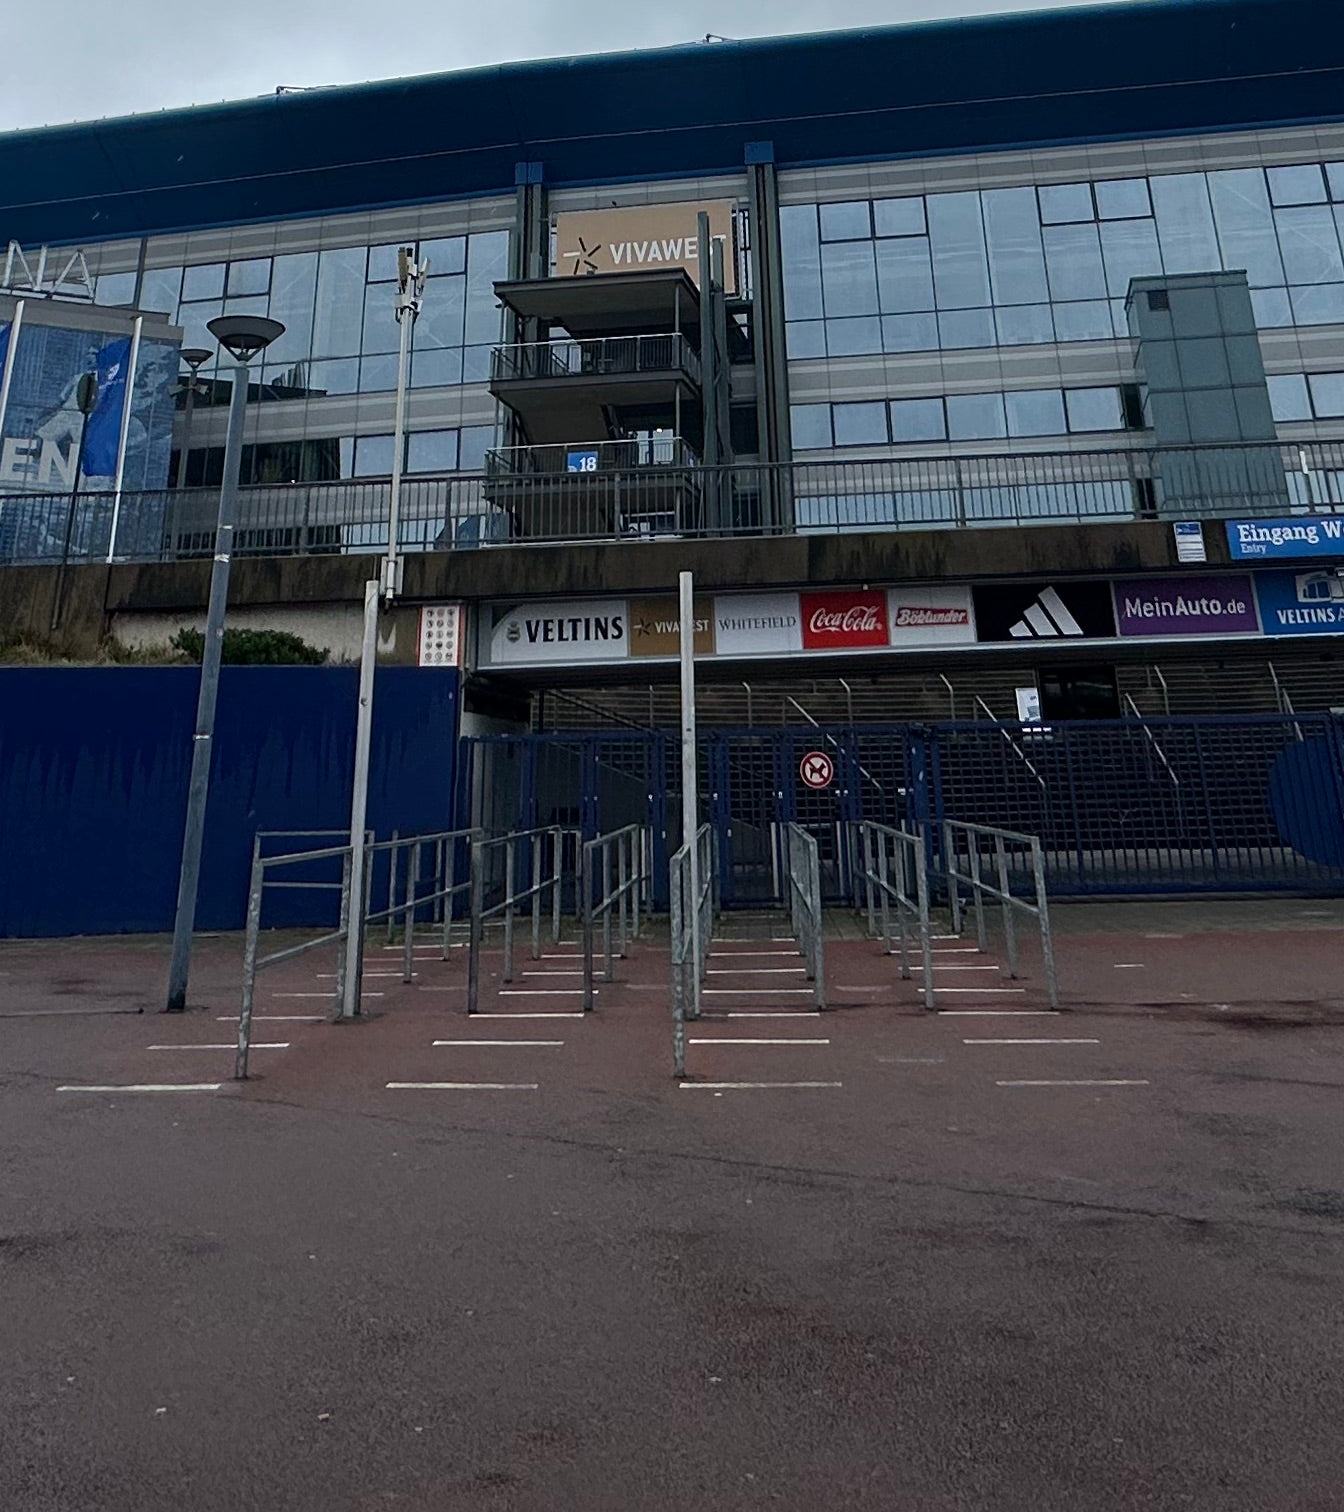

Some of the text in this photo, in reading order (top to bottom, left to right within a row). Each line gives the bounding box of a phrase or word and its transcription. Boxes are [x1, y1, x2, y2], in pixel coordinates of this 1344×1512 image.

[579, 456, 597, 472] 18
[1237, 523, 1318, 545] Eingang
[1241, 542, 1267, 555] Entry
[1124, 595, 1246, 619] MeinAuto.de
[1276, 607, 1335, 624] VELTINS
[525, 616, 624, 643] VELTINS
[718, 615, 796, 632] WHITEFIELD
